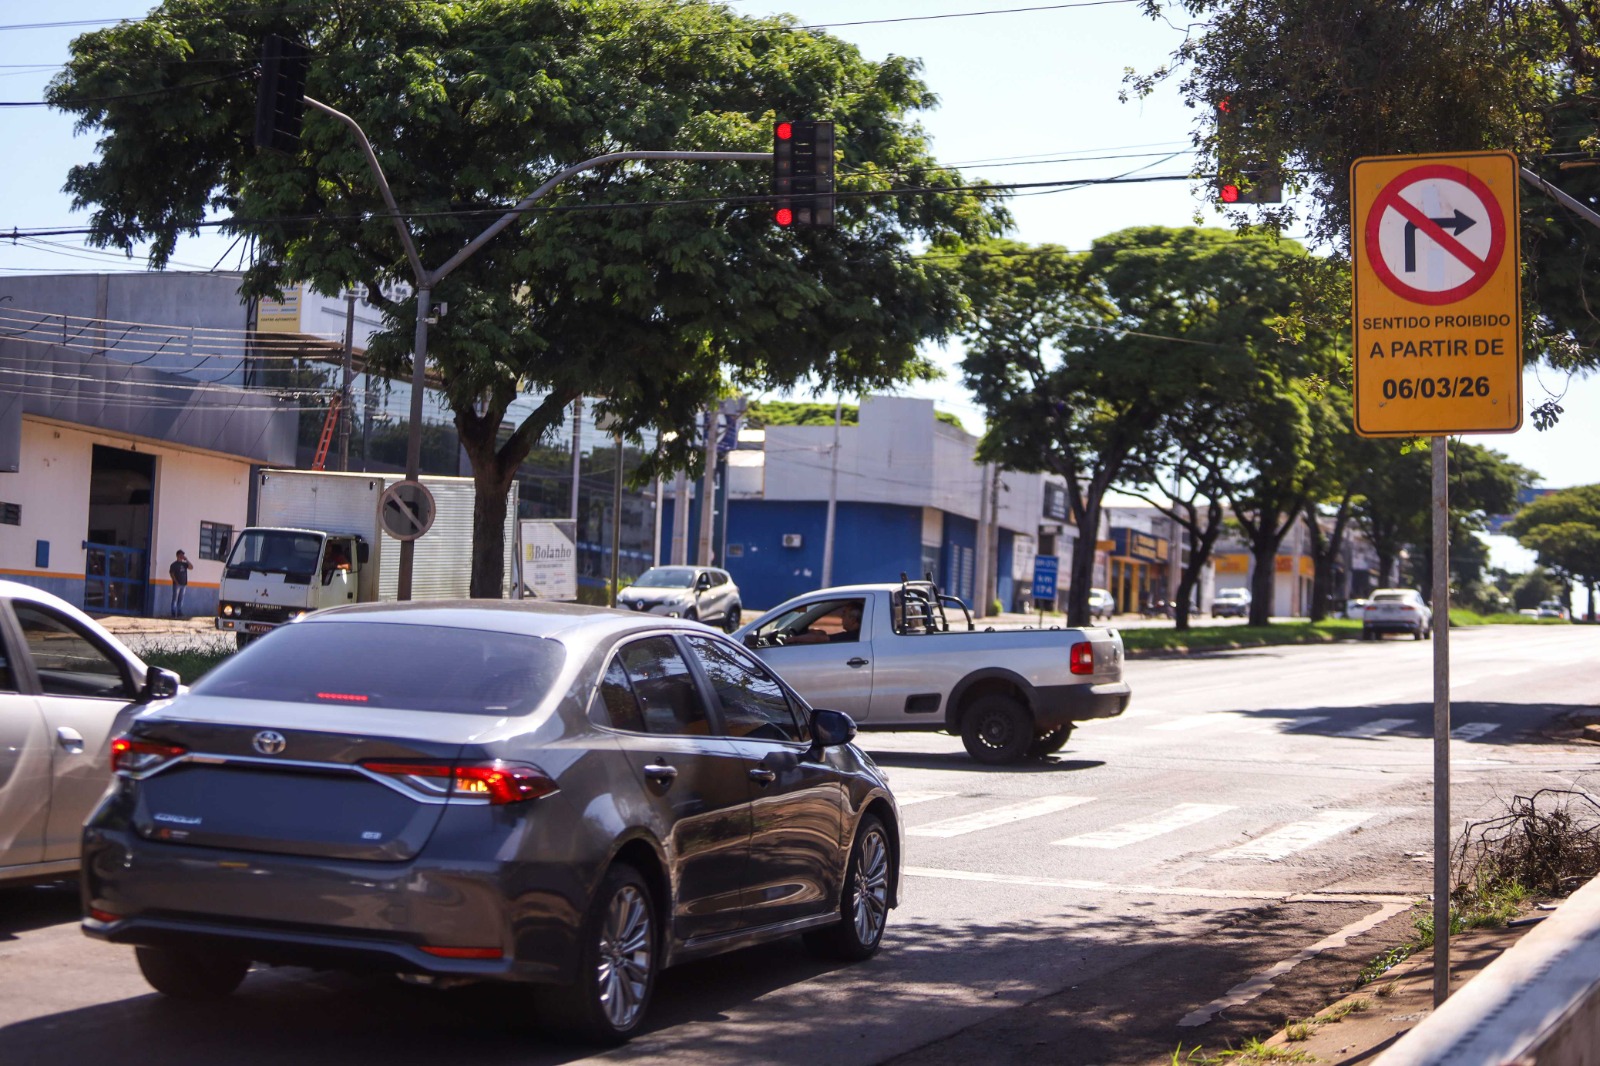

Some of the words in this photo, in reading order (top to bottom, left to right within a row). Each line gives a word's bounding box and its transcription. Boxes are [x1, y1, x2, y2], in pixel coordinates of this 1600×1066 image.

[1363, 316, 1430, 330] SENTIDO
[1435, 314, 1510, 327] PROIBIDO
[1370, 342, 1384, 358] A
[1392, 340, 1467, 358] PARTIR
[1475, 339, 1504, 356] DE
[1383, 376, 1490, 400] 06/03/26
[535, 544, 572, 559] Bolanho
[1037, 574, 1052, 584] km
